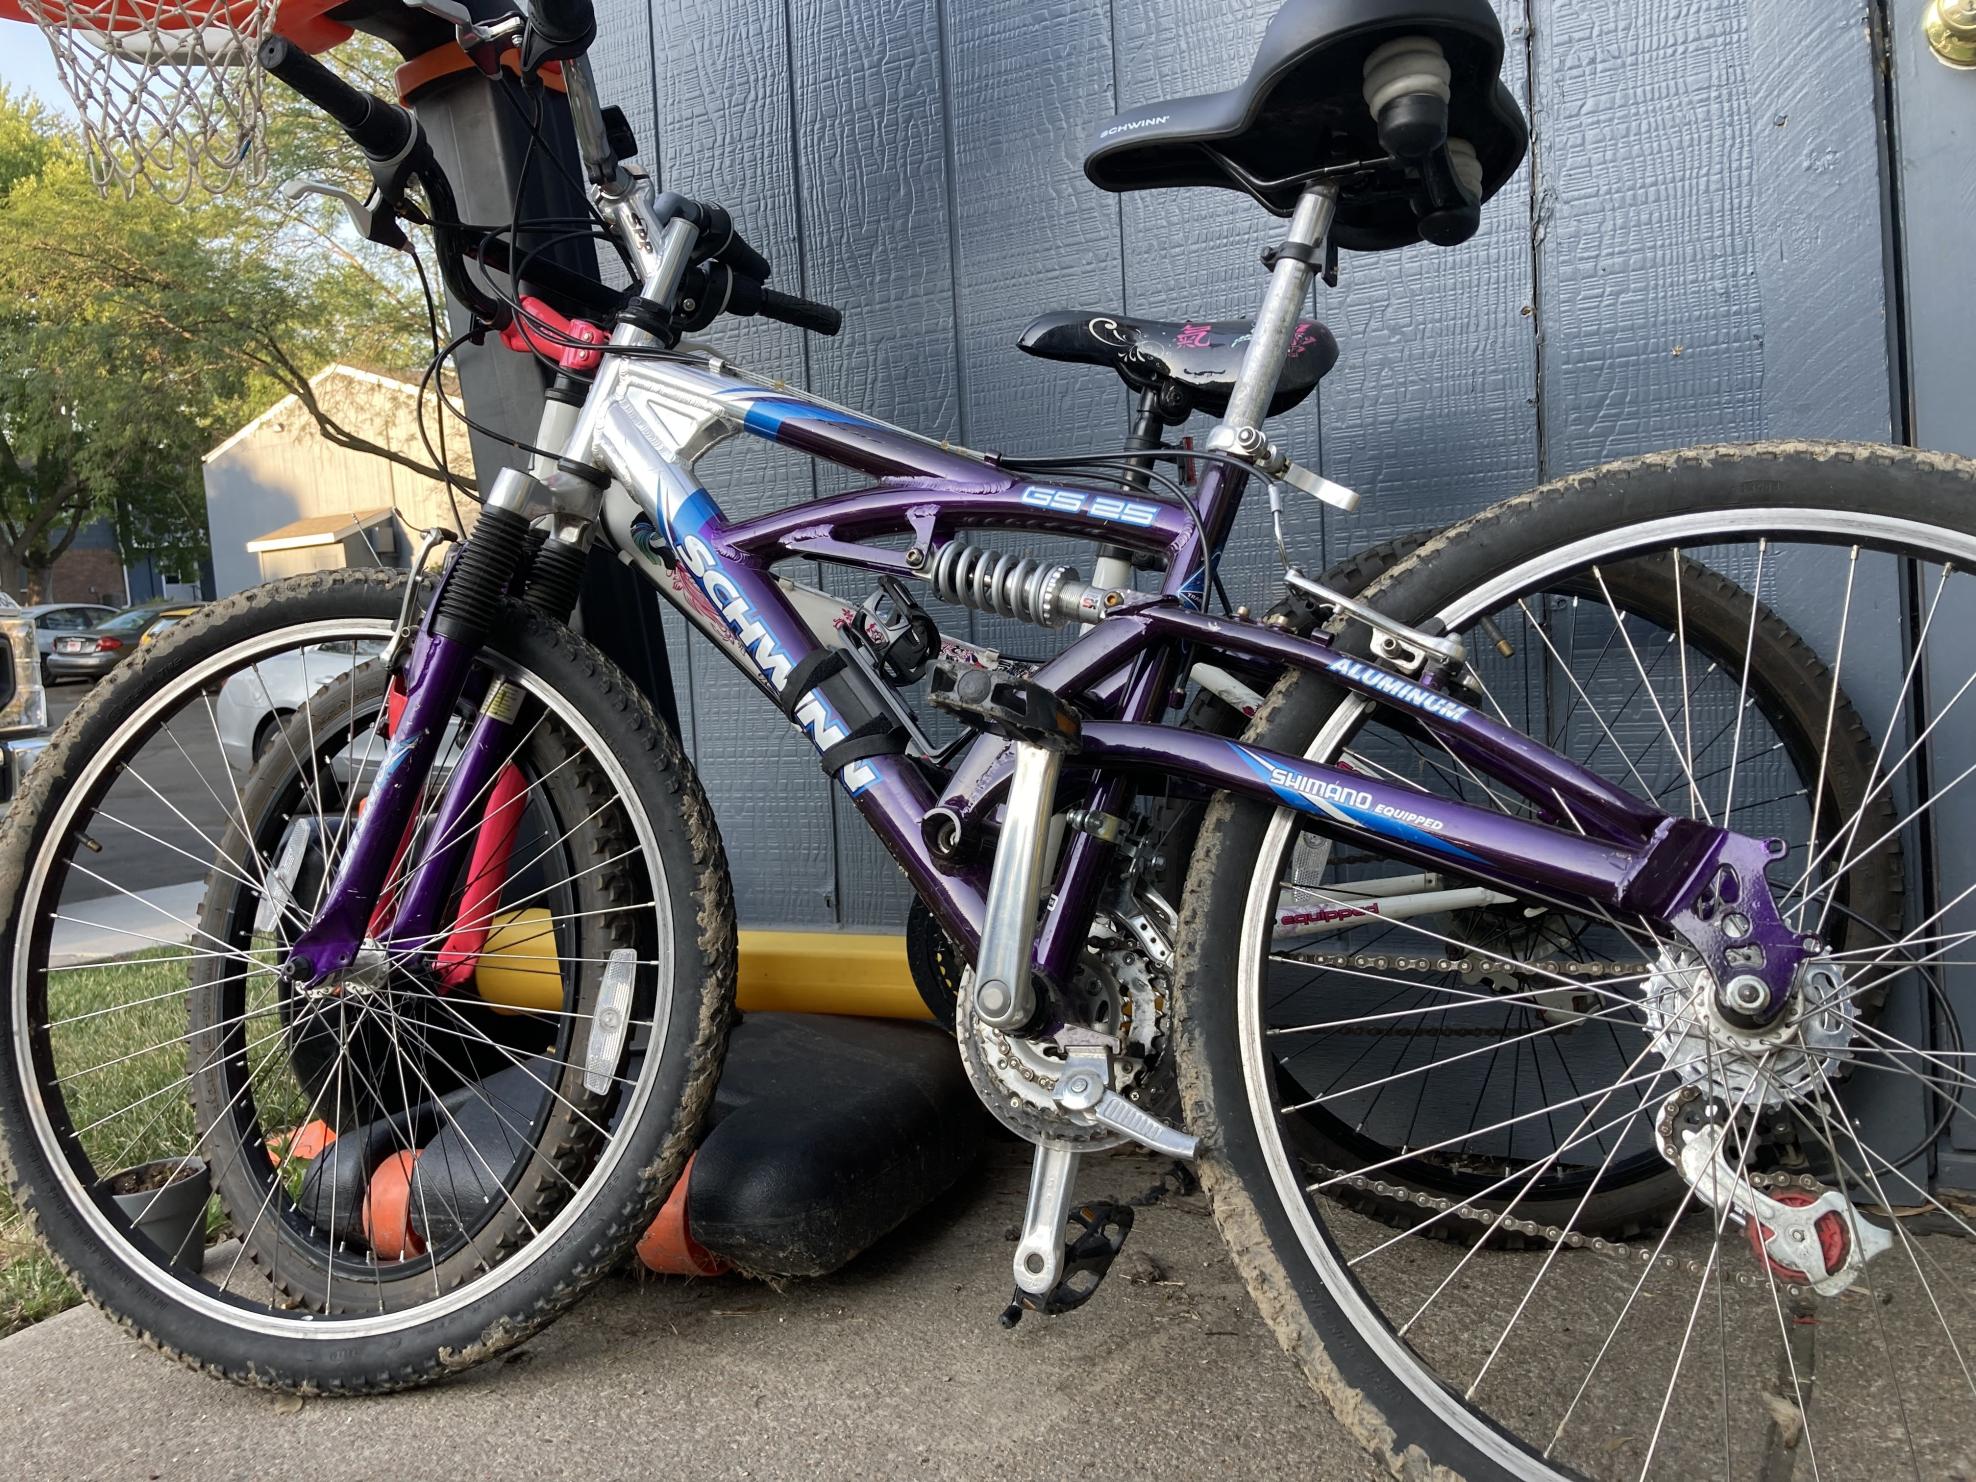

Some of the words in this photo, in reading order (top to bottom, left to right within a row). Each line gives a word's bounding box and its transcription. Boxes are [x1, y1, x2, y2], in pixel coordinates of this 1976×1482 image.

[1100, 115, 1167, 138] SCHWINN
[1022, 486, 1086, 512] GS
[1089, 497, 1159, 527] 25
[1329, 657, 1470, 722] ALUMINUM
[1270, 768, 1373, 811] SHIMANO
[1374, 803, 1444, 830] EQUIPPED
[1280, 902, 1380, 926] equipped
